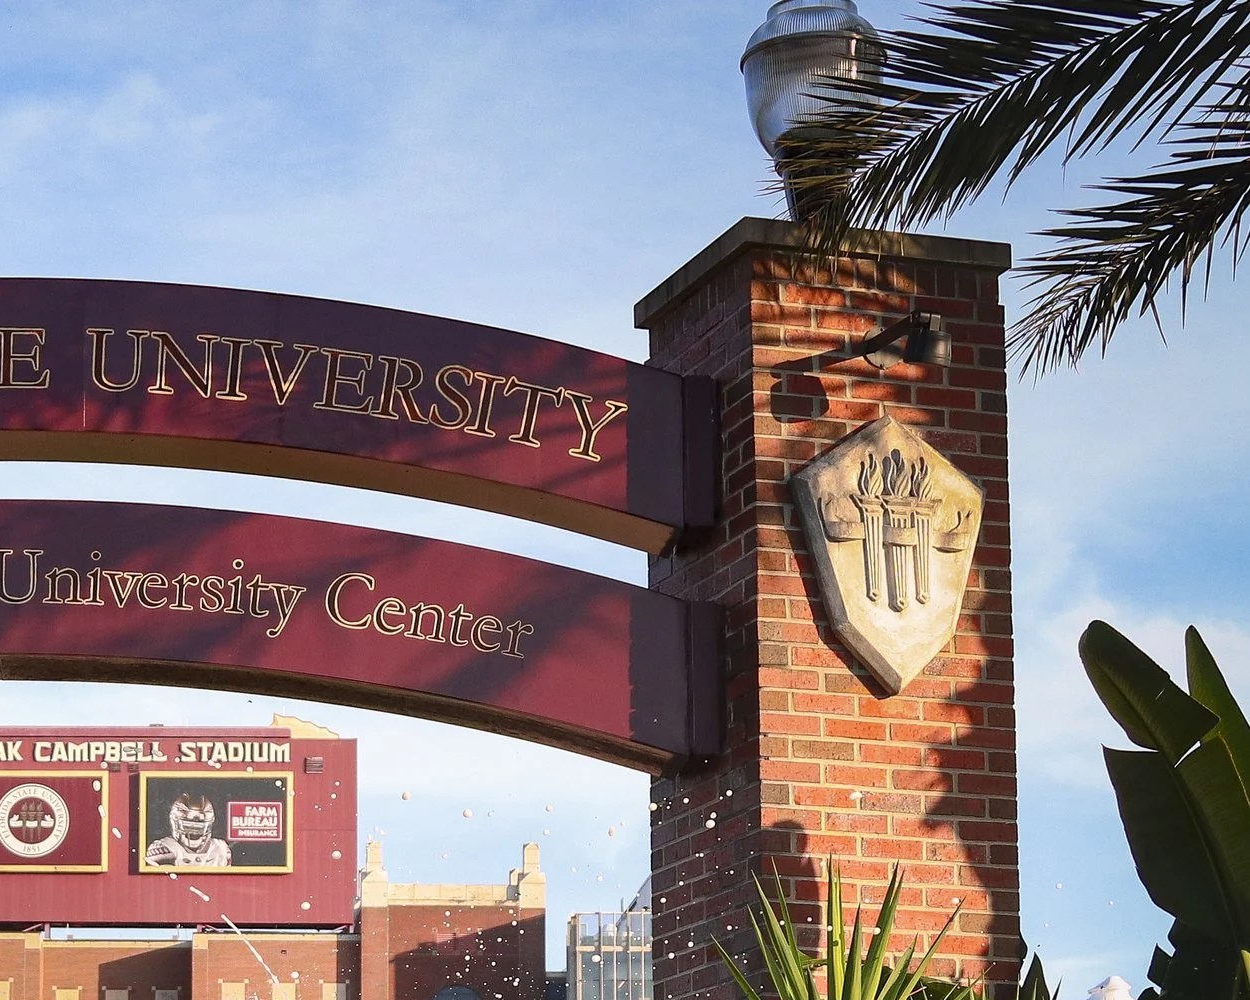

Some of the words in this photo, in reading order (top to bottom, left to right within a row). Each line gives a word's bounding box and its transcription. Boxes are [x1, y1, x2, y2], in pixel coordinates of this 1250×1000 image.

[86, 327, 627, 462] UNIVERSITY
[325, 572, 534, 659] Center
[33, 741, 167, 762] CAMPBELL
[180, 741, 290, 763] STADIUM
[12, 787, 39, 801] STATE
[41, 790, 65, 840] UNIVERSITY
[245, 806, 278, 816] FARM
[232, 816, 278, 827] BUREAU
[238, 829, 278, 837] INSURANCE
[22, 845, 41, 853] 1851
